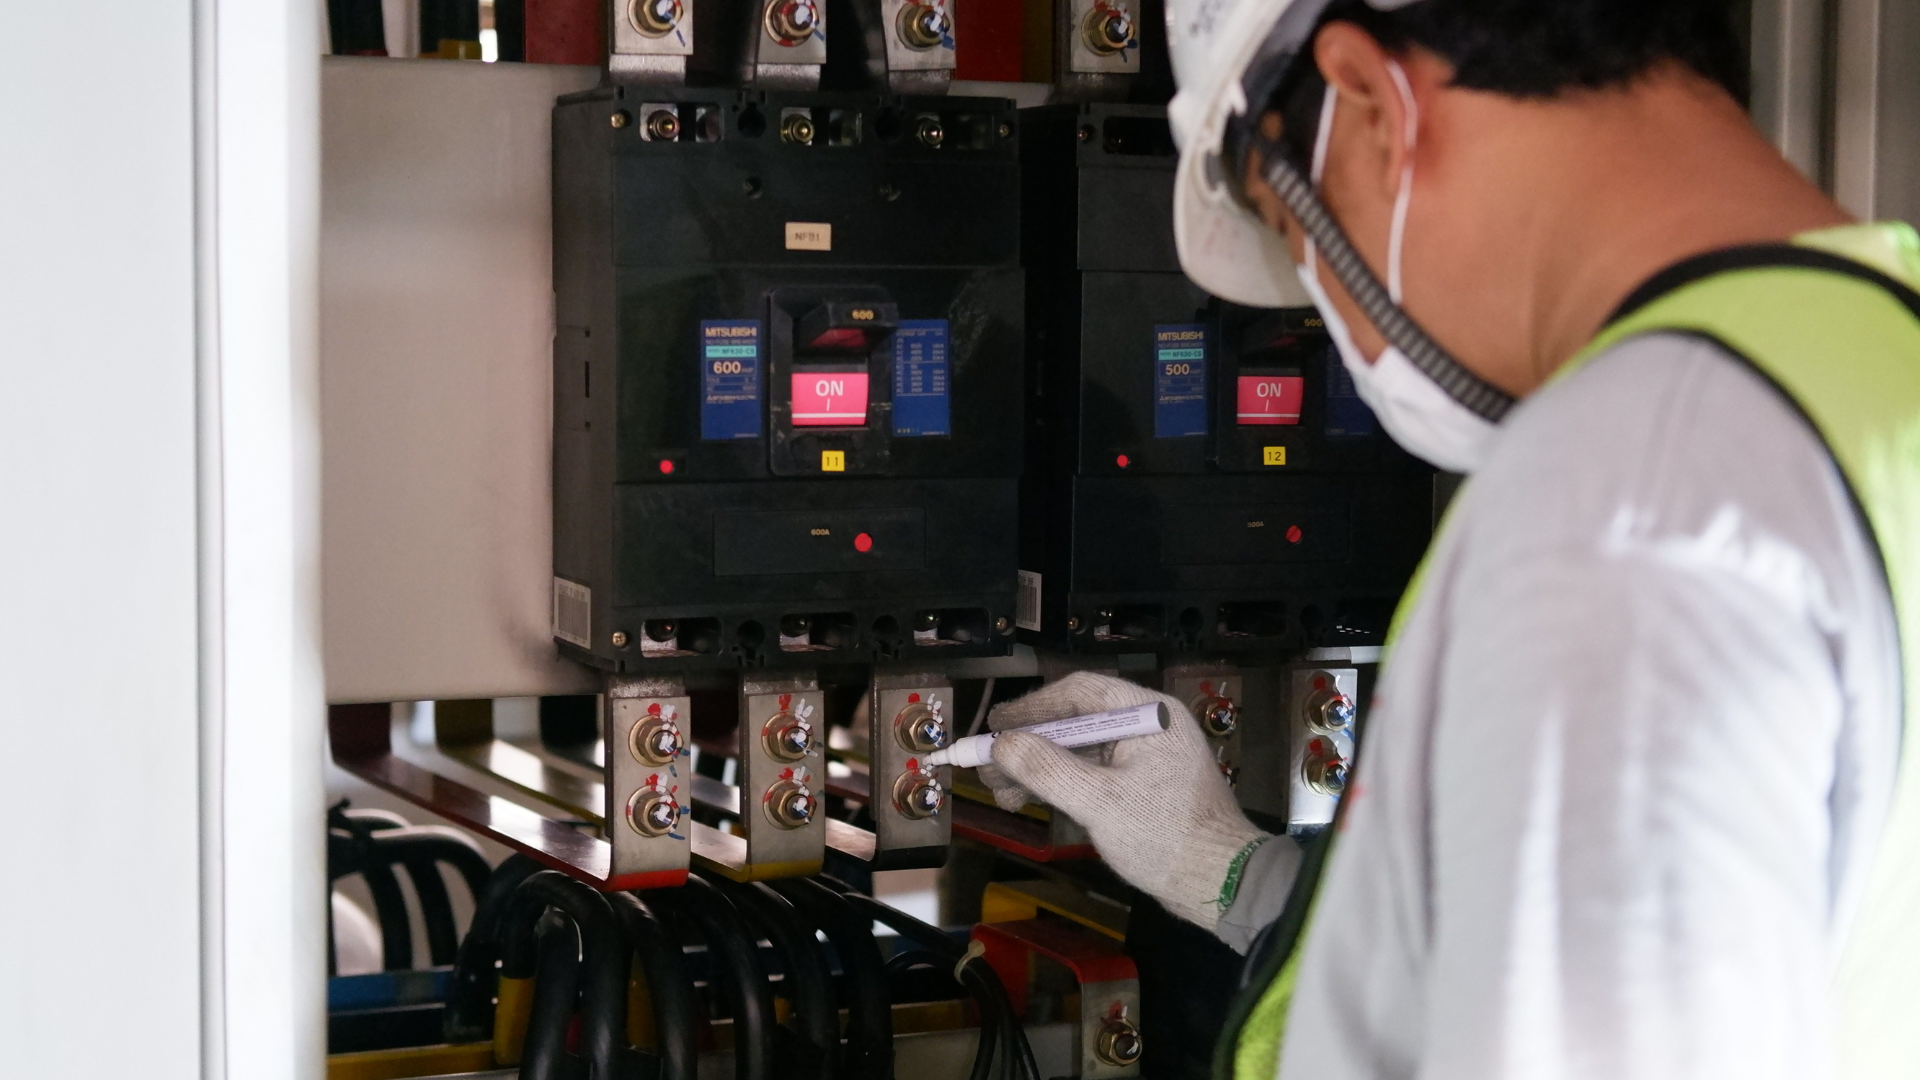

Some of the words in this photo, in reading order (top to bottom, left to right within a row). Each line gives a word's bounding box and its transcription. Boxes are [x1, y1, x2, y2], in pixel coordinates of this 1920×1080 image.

[852, 309, 874, 320] 600
[1304, 318, 1323, 327] 500
[705, 327, 757, 337] MITSUBISHI
[1158, 331, 1204, 341] MITSUBISHI
[713, 361, 742, 374] 600
[1165, 363, 1190, 376] 500
[815, 380, 844, 396] ON
[1256, 383, 1281, 397] ON
[1268, 452, 1282, 461] 12
[826, 457, 839, 467] 11
[811, 528, 830, 536] 600A
